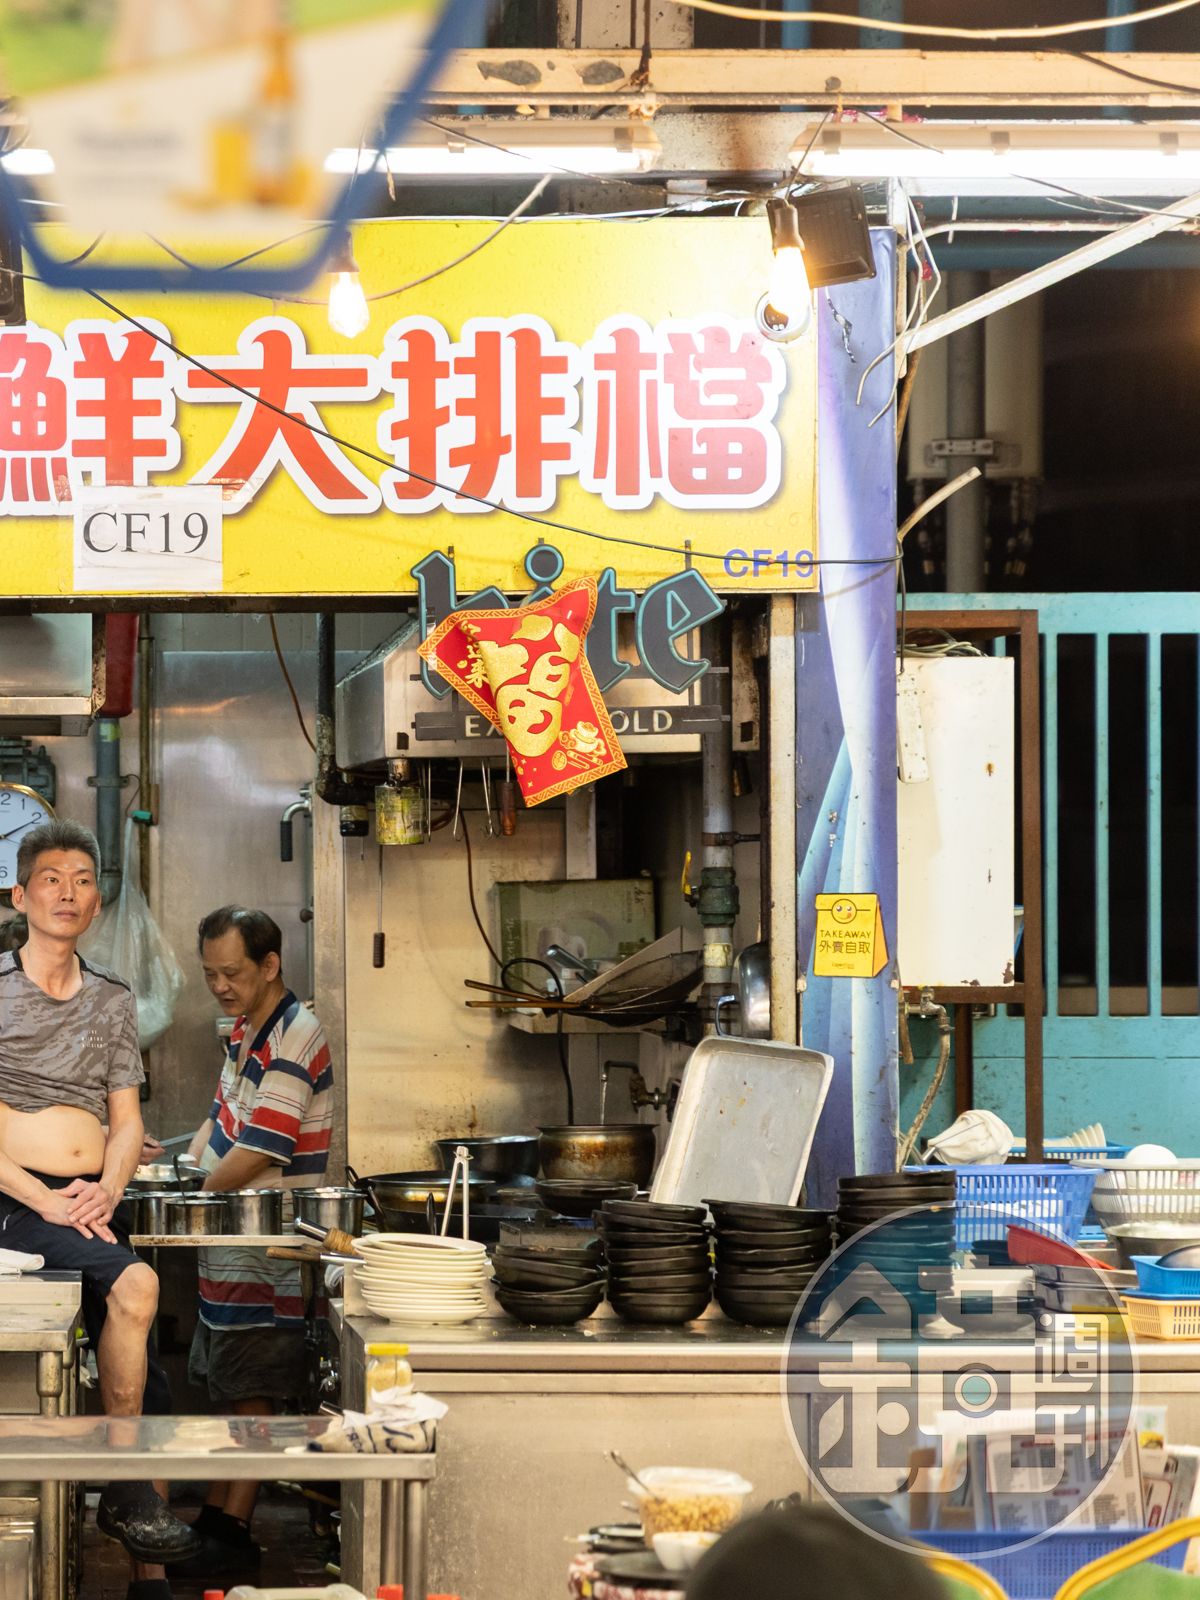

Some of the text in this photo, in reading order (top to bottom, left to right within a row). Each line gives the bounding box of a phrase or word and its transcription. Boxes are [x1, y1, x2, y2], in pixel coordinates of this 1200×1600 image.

[83, 512, 208, 553] CF19
[723, 548, 814, 578] CF19
[609, 710, 673, 733] OLD
[21, 798, 26, 810] 1
[31, 812, 42, 824] 2
[820, 930, 871, 938] TAKEAWAY
